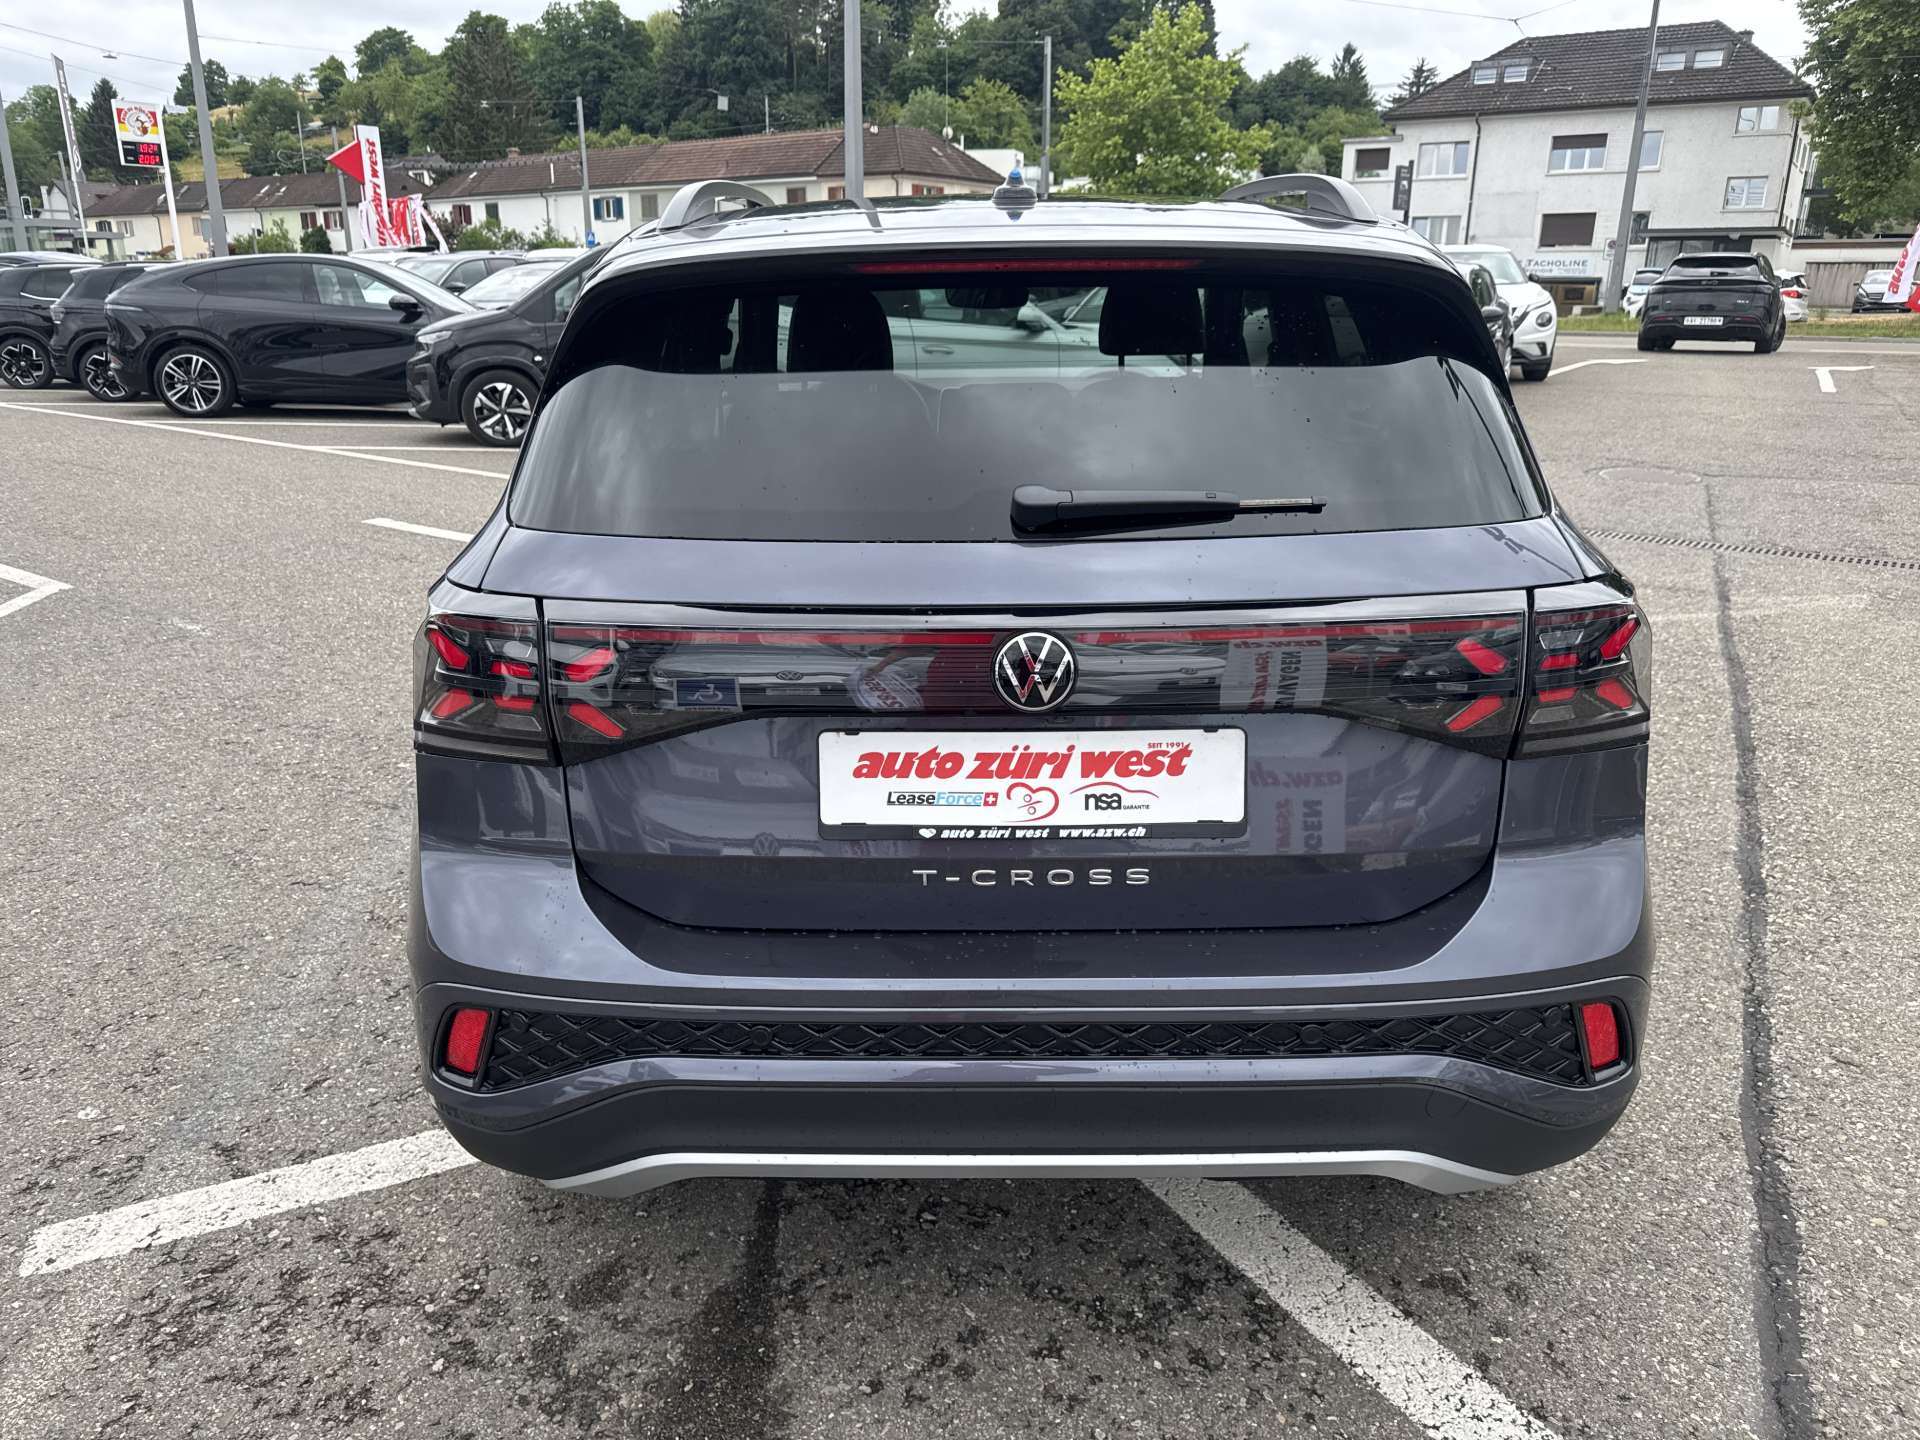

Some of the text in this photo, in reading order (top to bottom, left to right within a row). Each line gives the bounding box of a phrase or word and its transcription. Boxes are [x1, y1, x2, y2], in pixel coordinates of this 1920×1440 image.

[365, 137, 380, 179] west
[1526, 258, 1589, 268] TACHOLINE
[1887, 247, 1910, 295] auto
[1166, 741, 1185, 749] 1991
[852, 743, 1193, 780] auto züri west
[887, 791, 983, 806] LeaseForce
[1084, 793, 1122, 811] nsa
[940, 826, 1147, 838] auto züri west www.azw.ch
[912, 868, 1150, 887] T-CROSS
